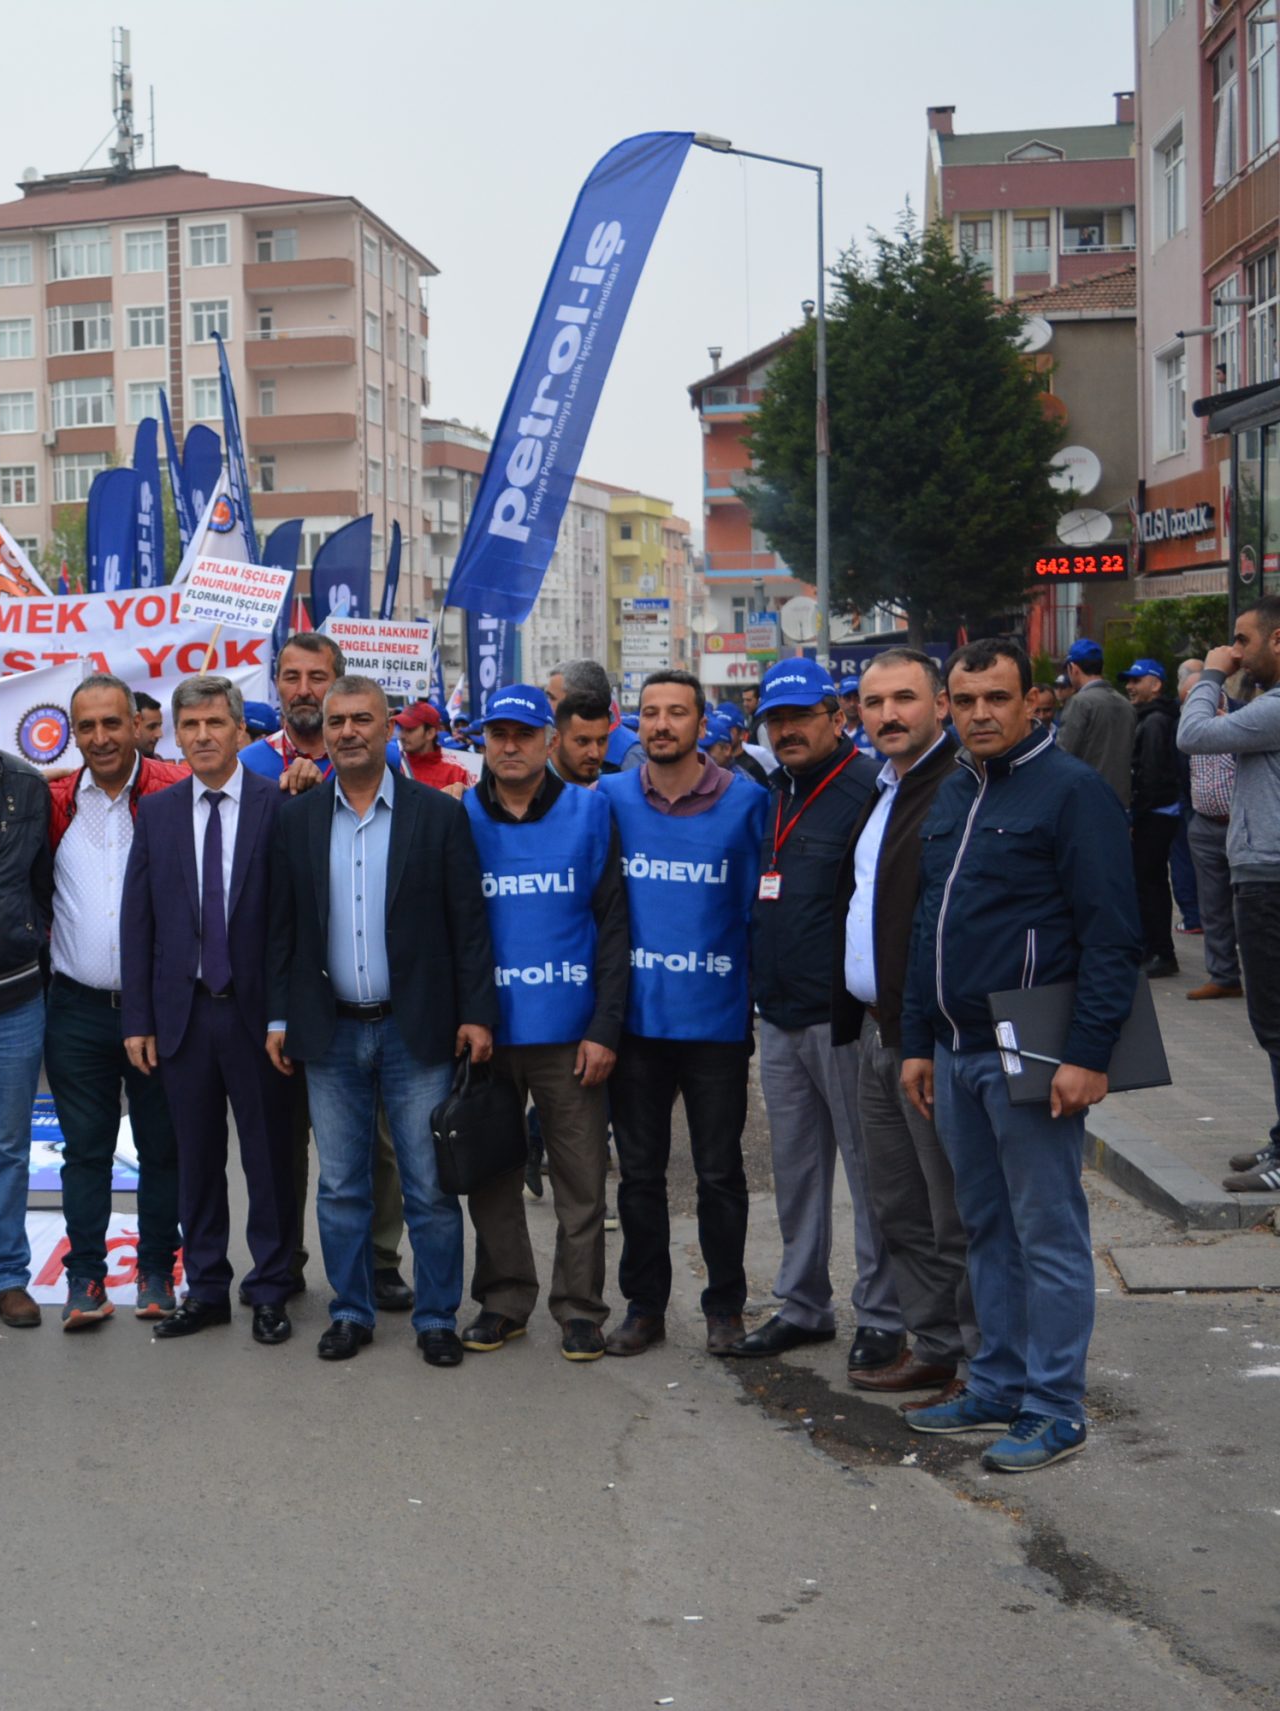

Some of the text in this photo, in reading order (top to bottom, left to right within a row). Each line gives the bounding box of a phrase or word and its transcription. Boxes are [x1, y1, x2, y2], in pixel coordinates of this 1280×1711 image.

[488, 219, 626, 543] petrol-iş
[527, 478, 549, 522] Türkiye
[542, 440, 559, 477] Petrol
[553, 401, 572, 439] Kimya
[565, 359, 585, 399] Lastik
[592, 262, 621, 319] Sendikası
[197, 561, 287, 586] ATILAN İŞÇİLER
[1035, 555, 1124, 576] 642 32 22
[191, 575, 282, 601] ONURUMUZDUR
[186, 589, 278, 614] FLORMAR İŞÇİLERİ
[193, 605, 259, 627] petrol-iş
[331, 623, 429, 639] SENDİKA HAKKIMIZ
[136, 639, 267, 678] YOK
[339, 640, 419, 656] ENGELLENEMEZ
[343, 656, 428, 673] ORMAR İŞÇİLERİ
[766, 674, 807, 692] petrol-iş
[494, 697, 536, 711] petrol-iş
[481, 868, 575, 898] ÖREVLİ
[494, 961, 588, 986] trol-iş
[630, 947, 733, 977] trol-iş
